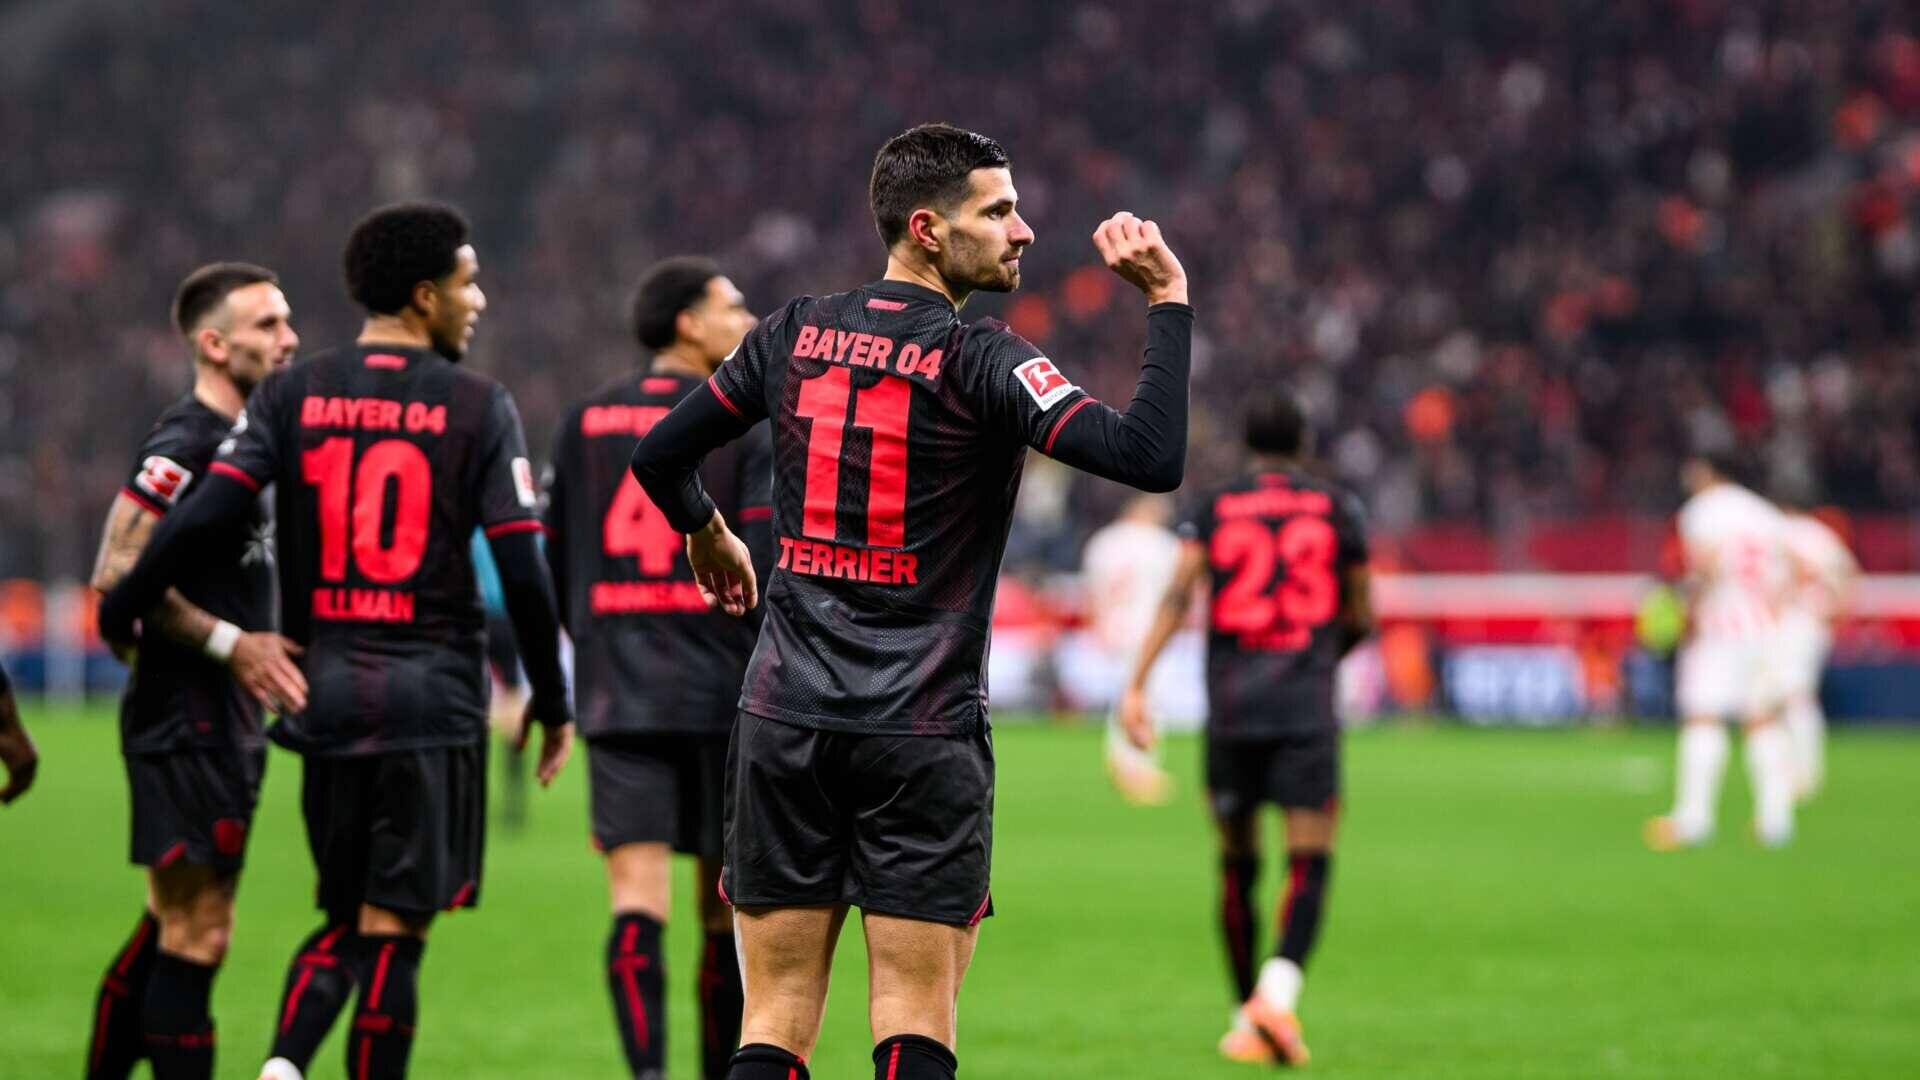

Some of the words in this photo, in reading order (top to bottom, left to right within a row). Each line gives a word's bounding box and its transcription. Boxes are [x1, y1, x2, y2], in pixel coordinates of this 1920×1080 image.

[792, 325, 893, 369] BAYER
[895, 345, 944, 381] 04
[301, 396, 402, 429] BAYER
[405, 402, 446, 435] 04
[795, 365, 911, 547] 11
[302, 436, 432, 584] 10
[777, 536, 919, 585] TERRIER
[1210, 518, 1339, 632] 23
[311, 587, 415, 623] ILLMAN
